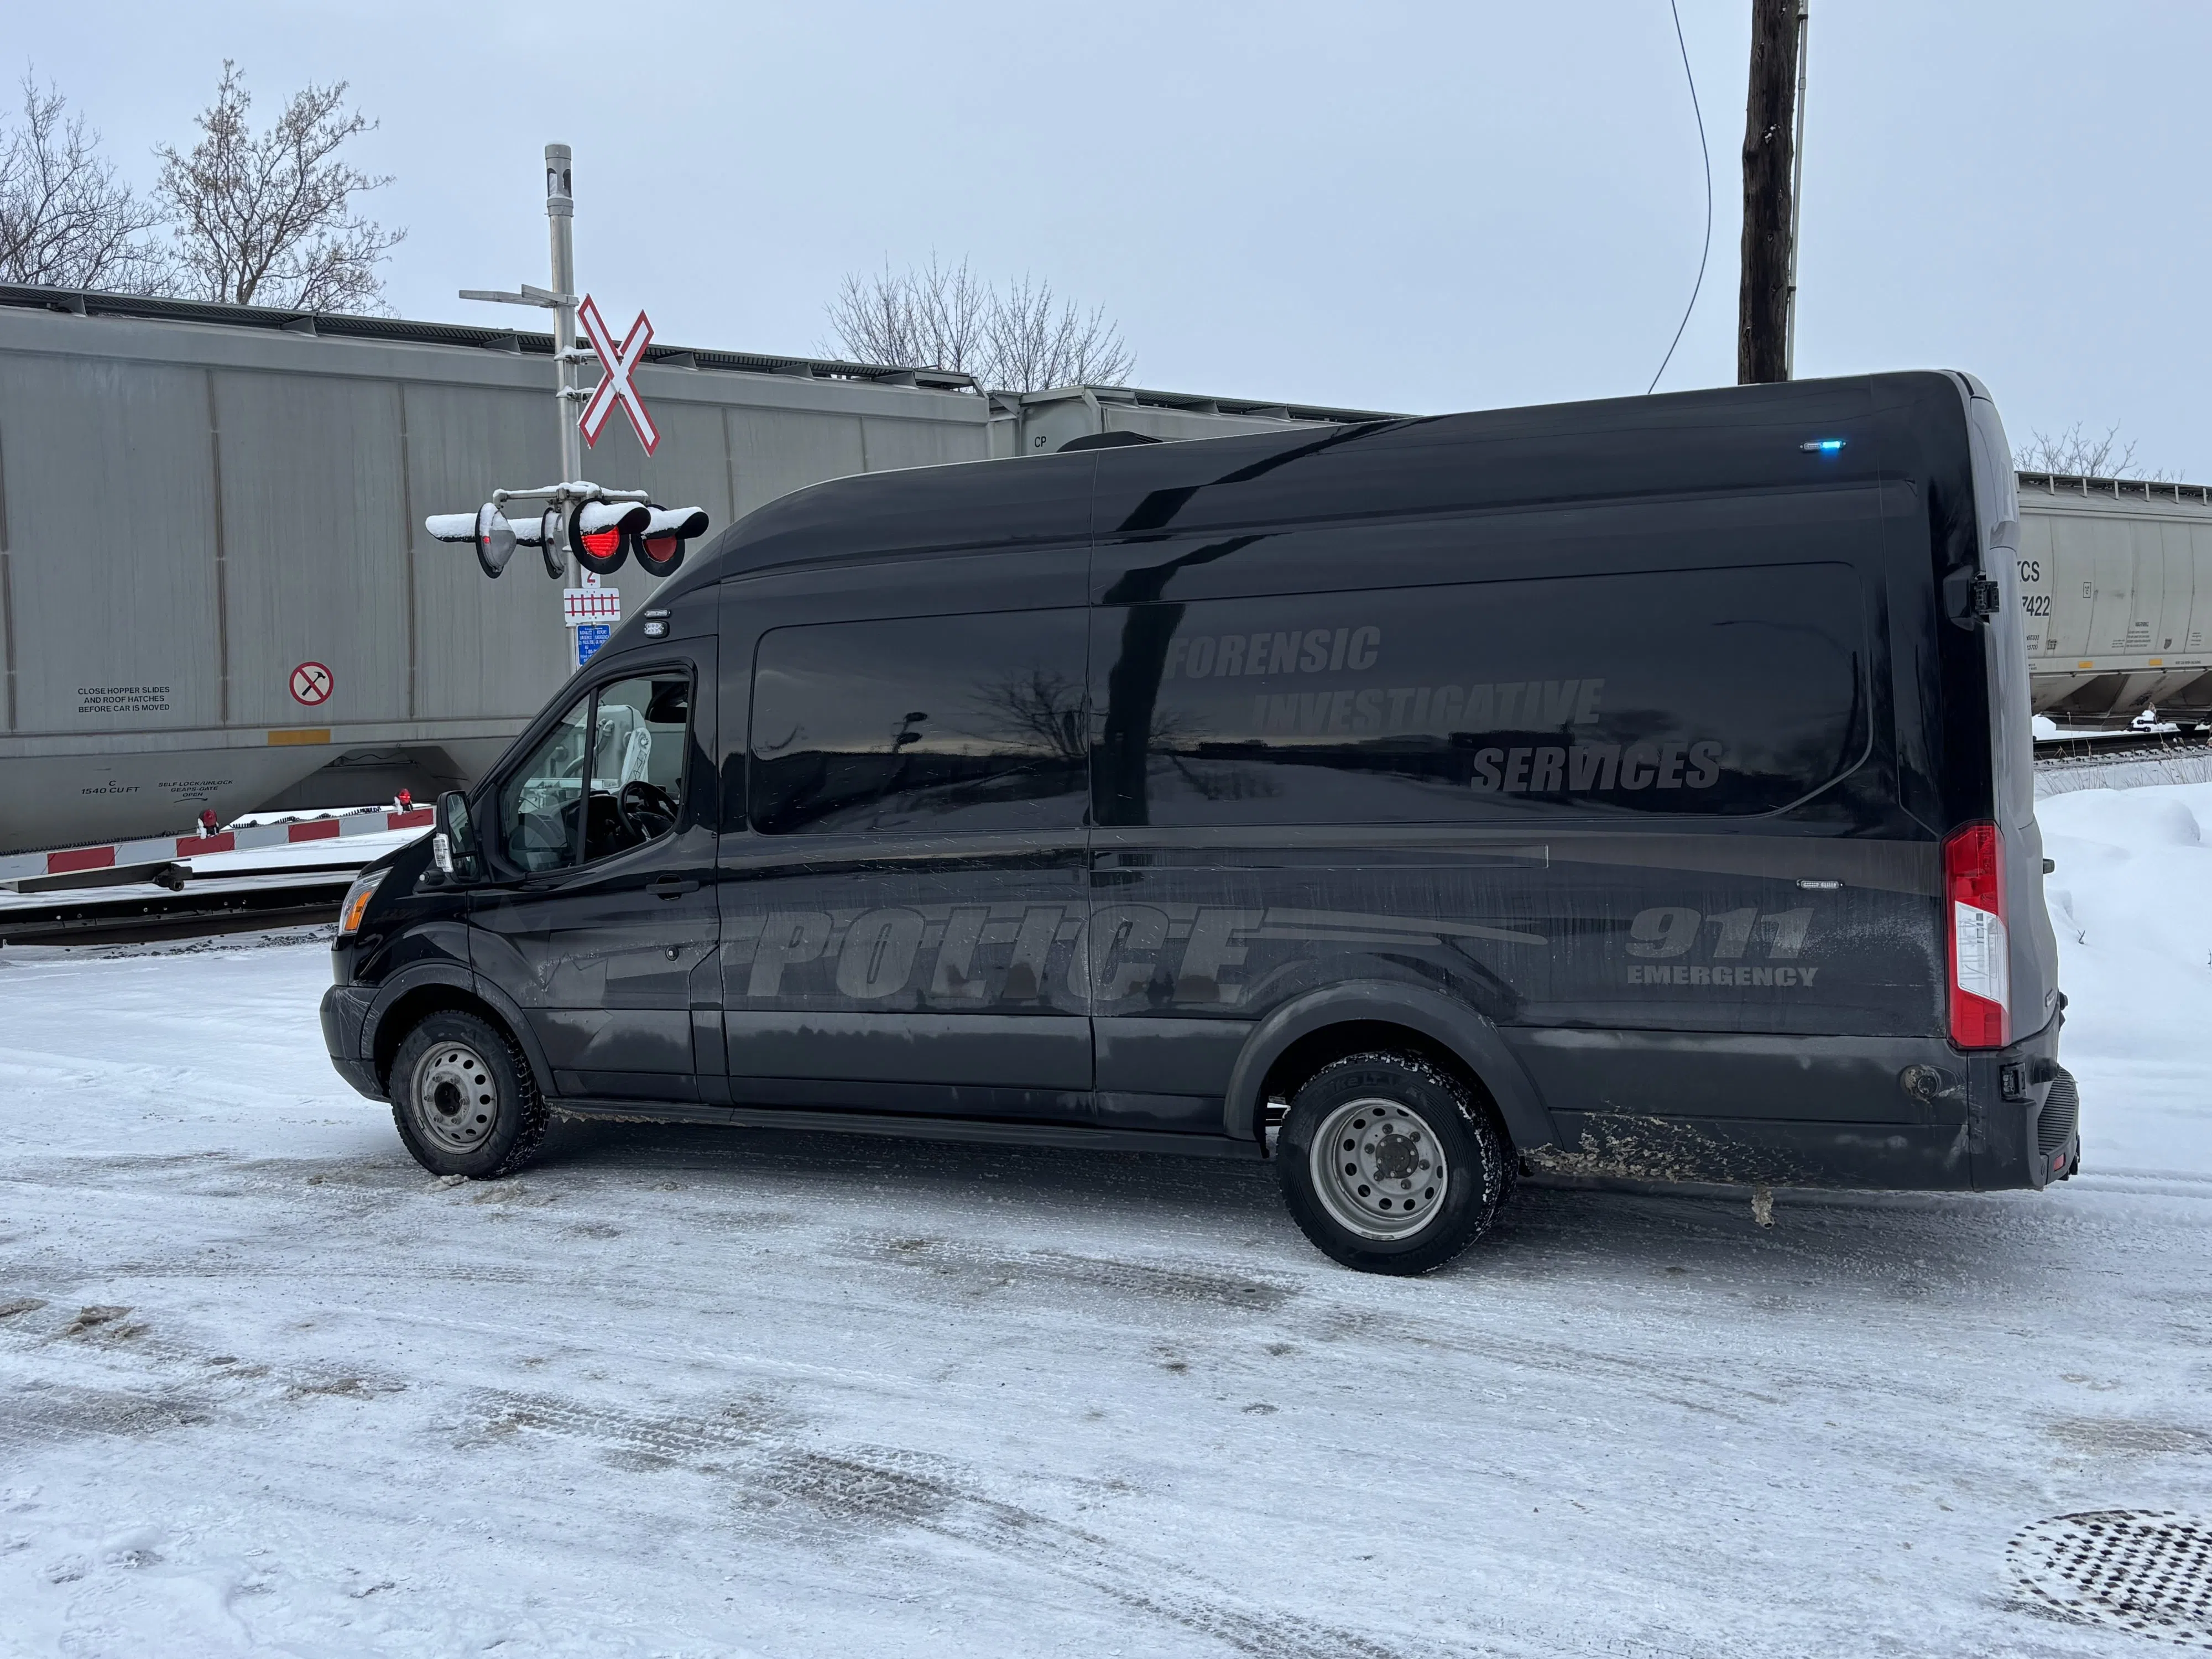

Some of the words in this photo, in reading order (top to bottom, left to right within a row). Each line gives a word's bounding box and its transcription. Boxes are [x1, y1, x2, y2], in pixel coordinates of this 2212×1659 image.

[1035, 436, 1047, 448] CP
[2017, 561, 2040, 582] CS
[1164, 625, 1381, 680] FORENSIC
[1251, 677, 1606, 736] INVESTIGATIVE
[1470, 740, 1724, 793] SERVICES
[747, 905, 1269, 1003] POLICE
[1625, 906, 1815, 959] 911
[1627, 964, 1819, 987] EMERGENCY
